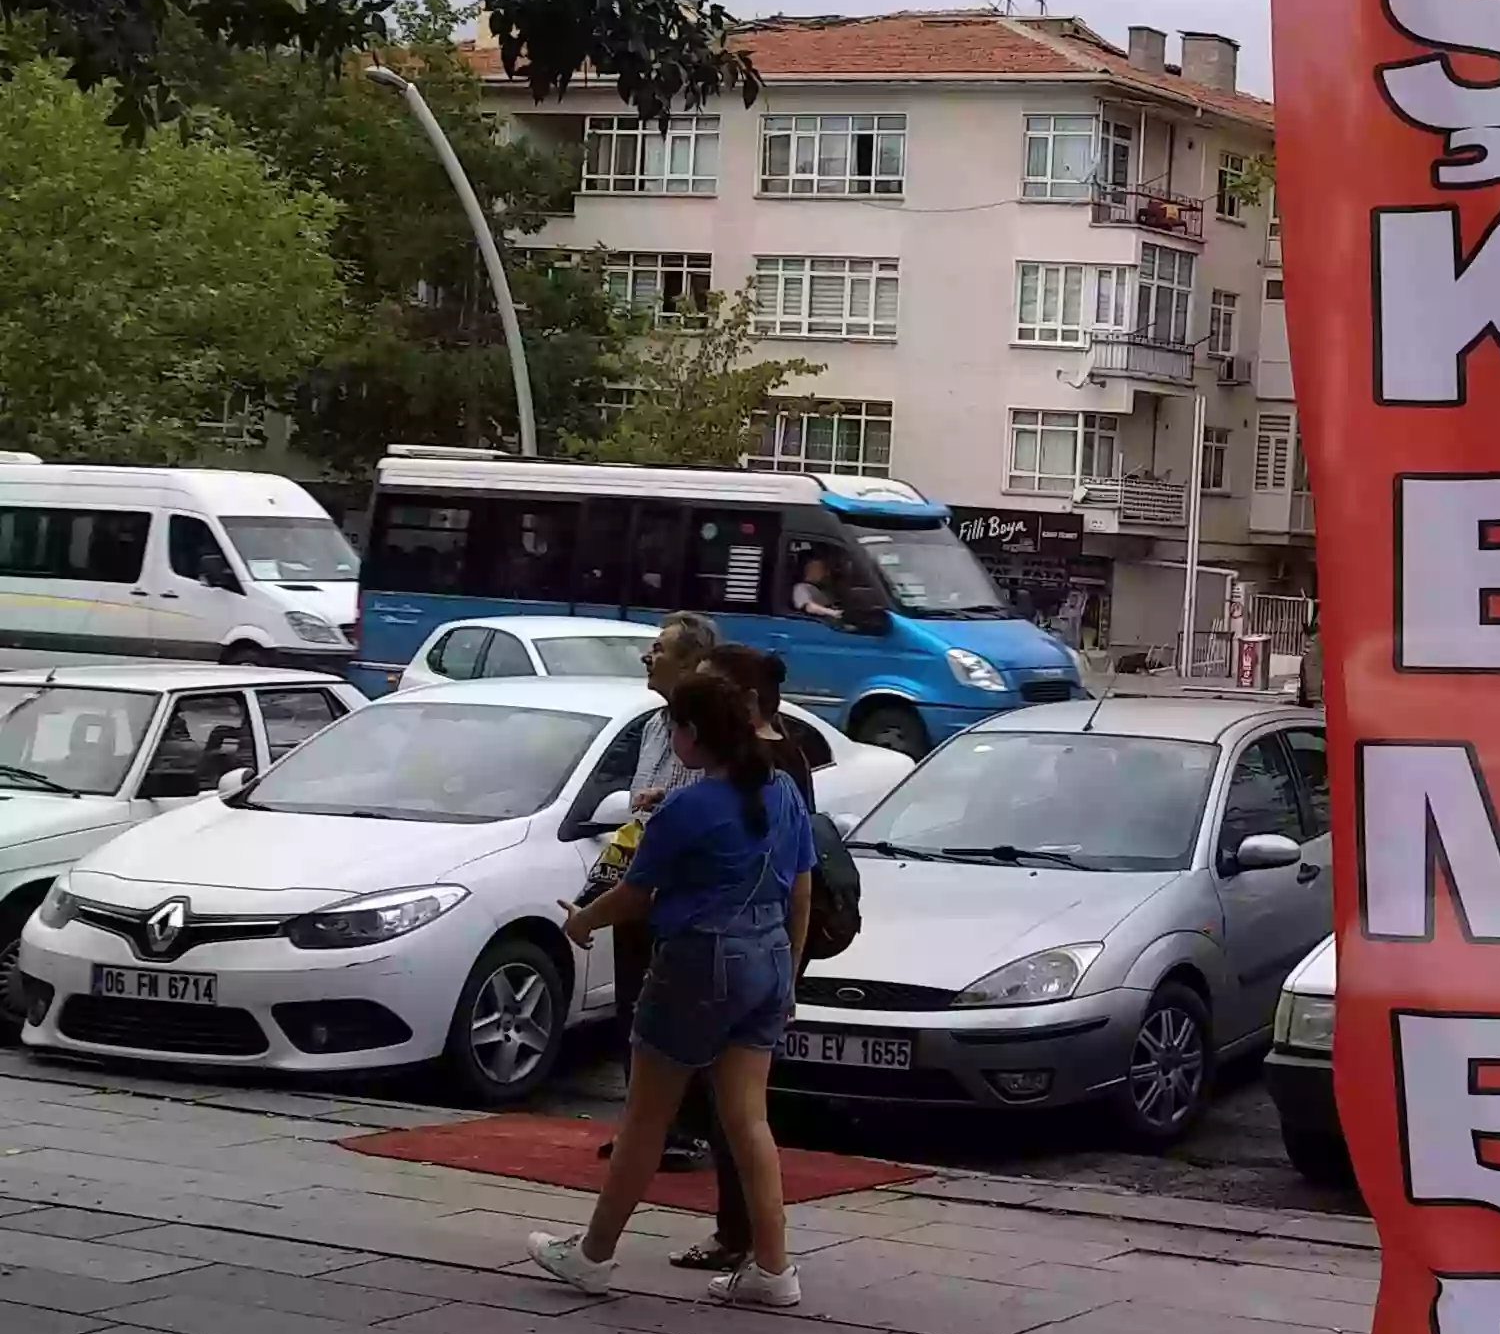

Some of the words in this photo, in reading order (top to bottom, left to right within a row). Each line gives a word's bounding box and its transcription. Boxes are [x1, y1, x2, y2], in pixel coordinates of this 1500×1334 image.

[959, 518, 985, 542] Filli
[988, 516, 1027, 542] Boya
[105, 970, 125, 995] 06
[137, 973, 159, 998] FN
[168, 976, 214, 1003] 6714
[786, 1033, 809, 1059] 06
[861, 1040, 909, 1066] 1655
